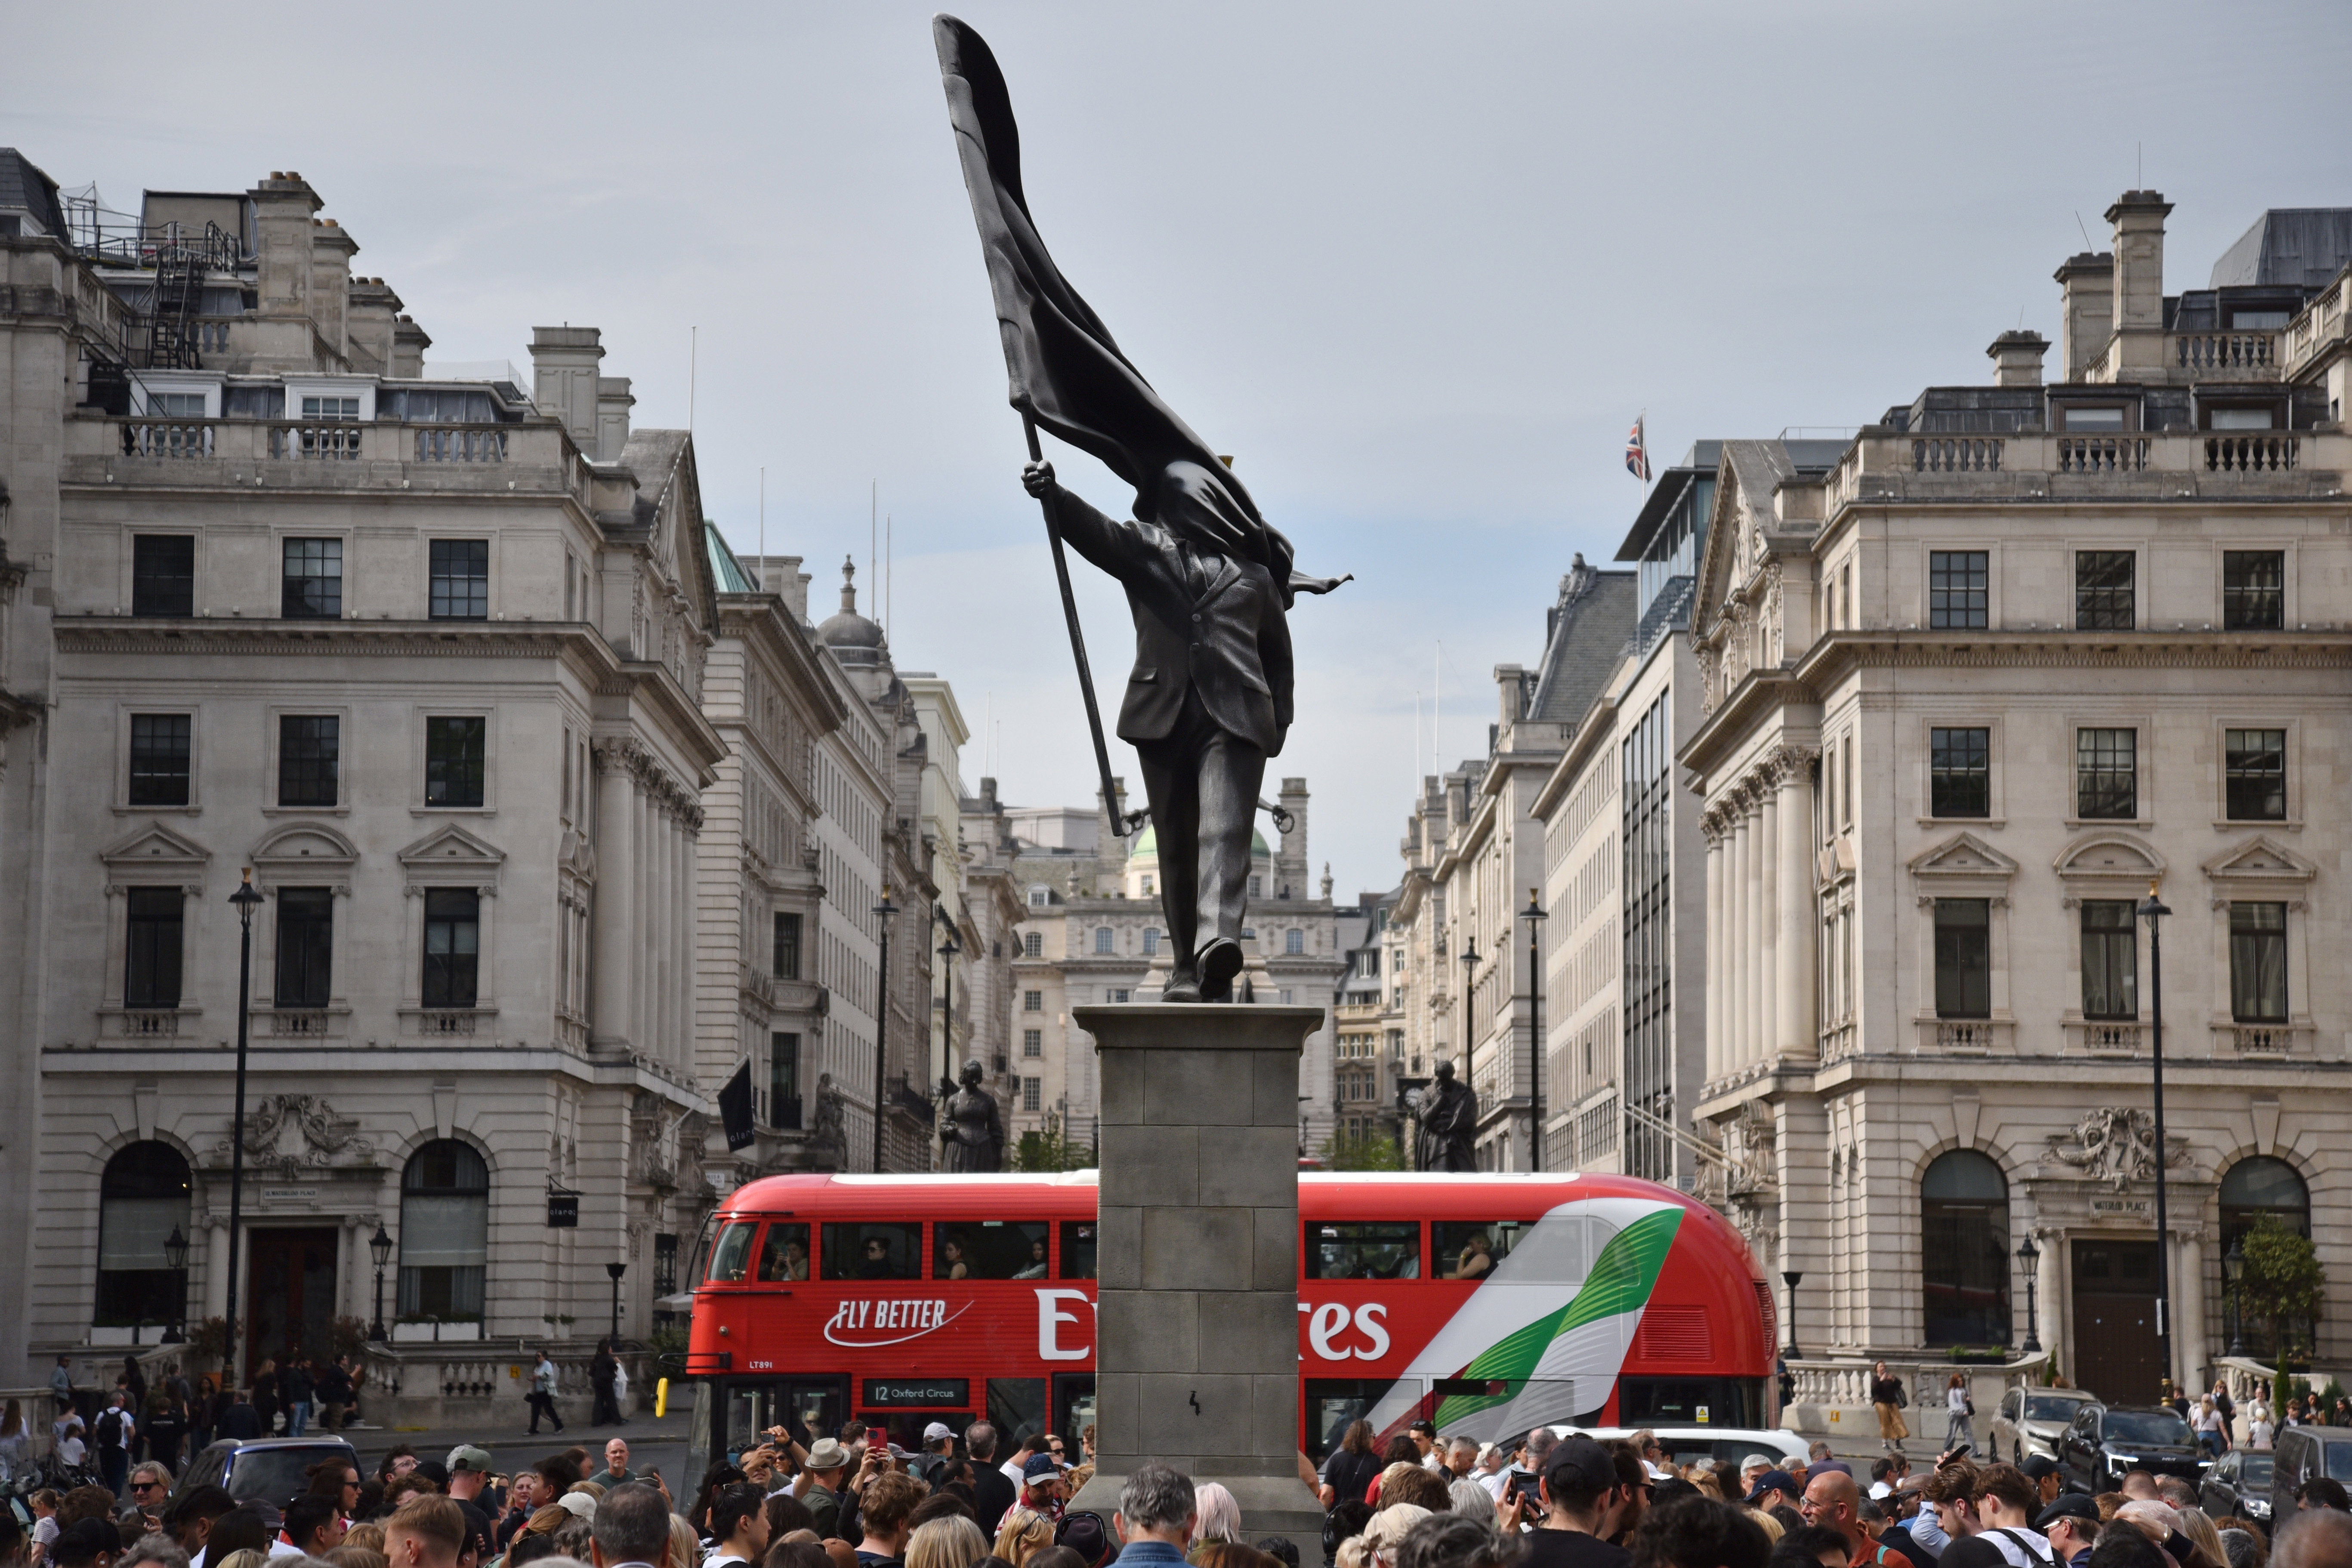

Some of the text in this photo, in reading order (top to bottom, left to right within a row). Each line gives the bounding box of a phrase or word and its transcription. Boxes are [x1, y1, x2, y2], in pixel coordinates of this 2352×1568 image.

[2114, 1142, 2128, 1169] 7
[836, 1300, 946, 1329] FLY BETTER
[875, 1386, 954, 1400] 12 Oxford Circus
